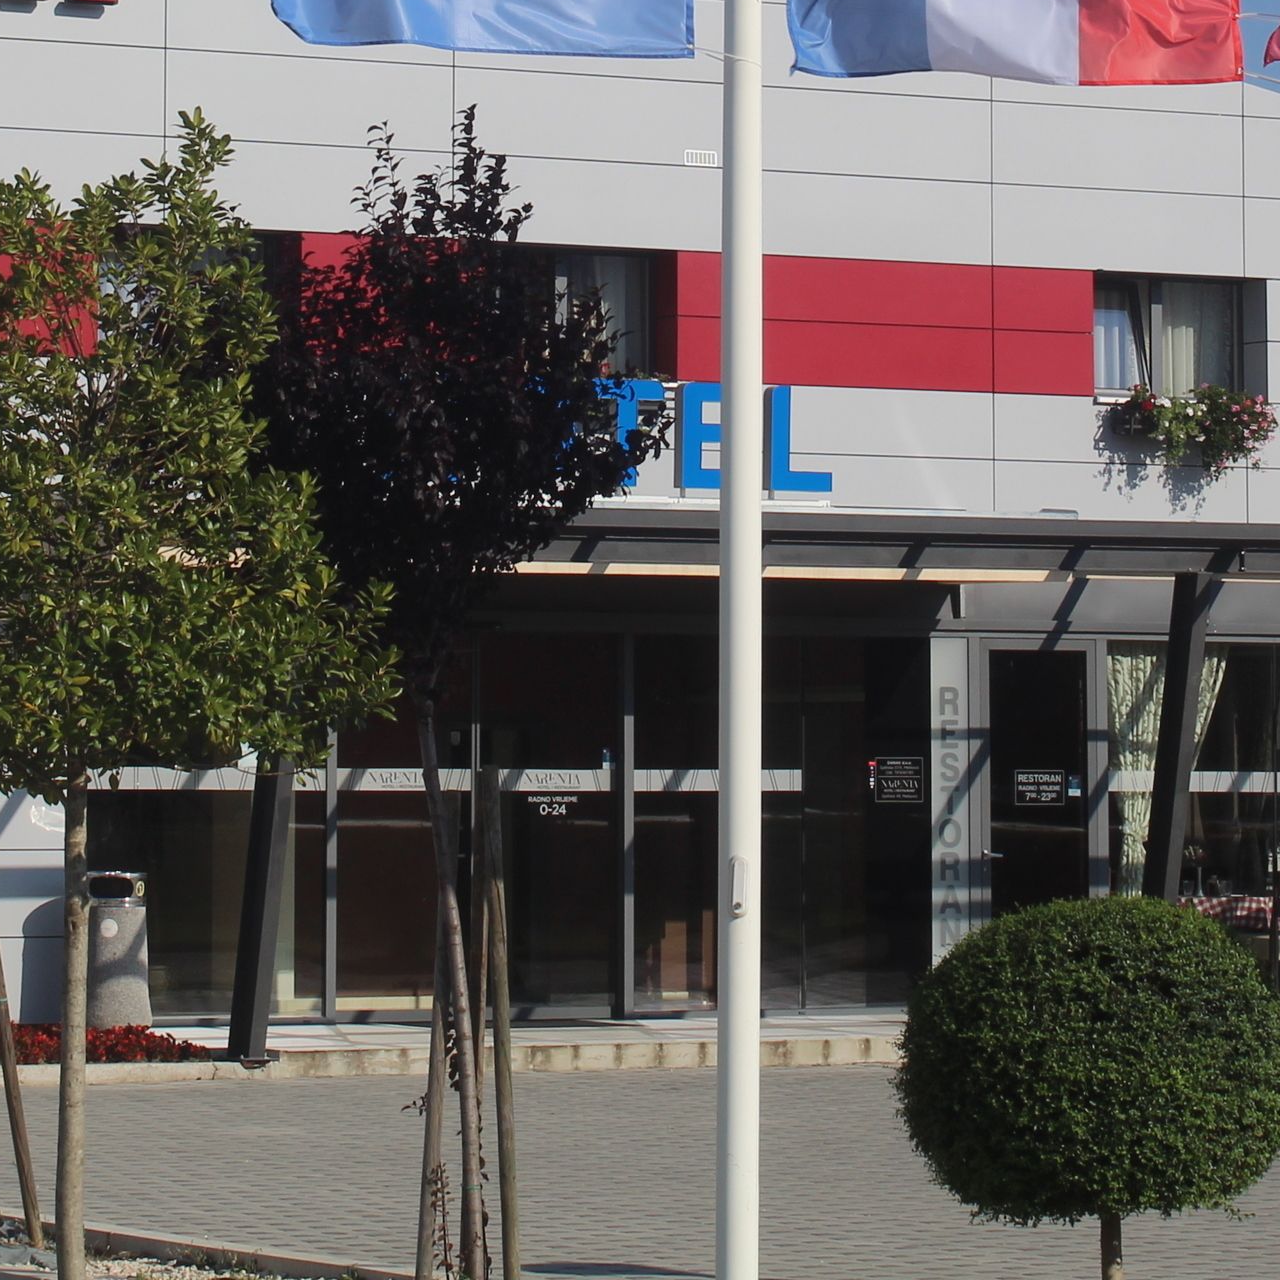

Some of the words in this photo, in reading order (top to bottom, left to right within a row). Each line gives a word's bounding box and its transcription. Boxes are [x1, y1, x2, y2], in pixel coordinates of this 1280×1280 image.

[1018, 774, 1062, 783] RESTORAN
[539, 804, 567, 815] 0-24
[938, 685, 962, 949] RESTORAN
